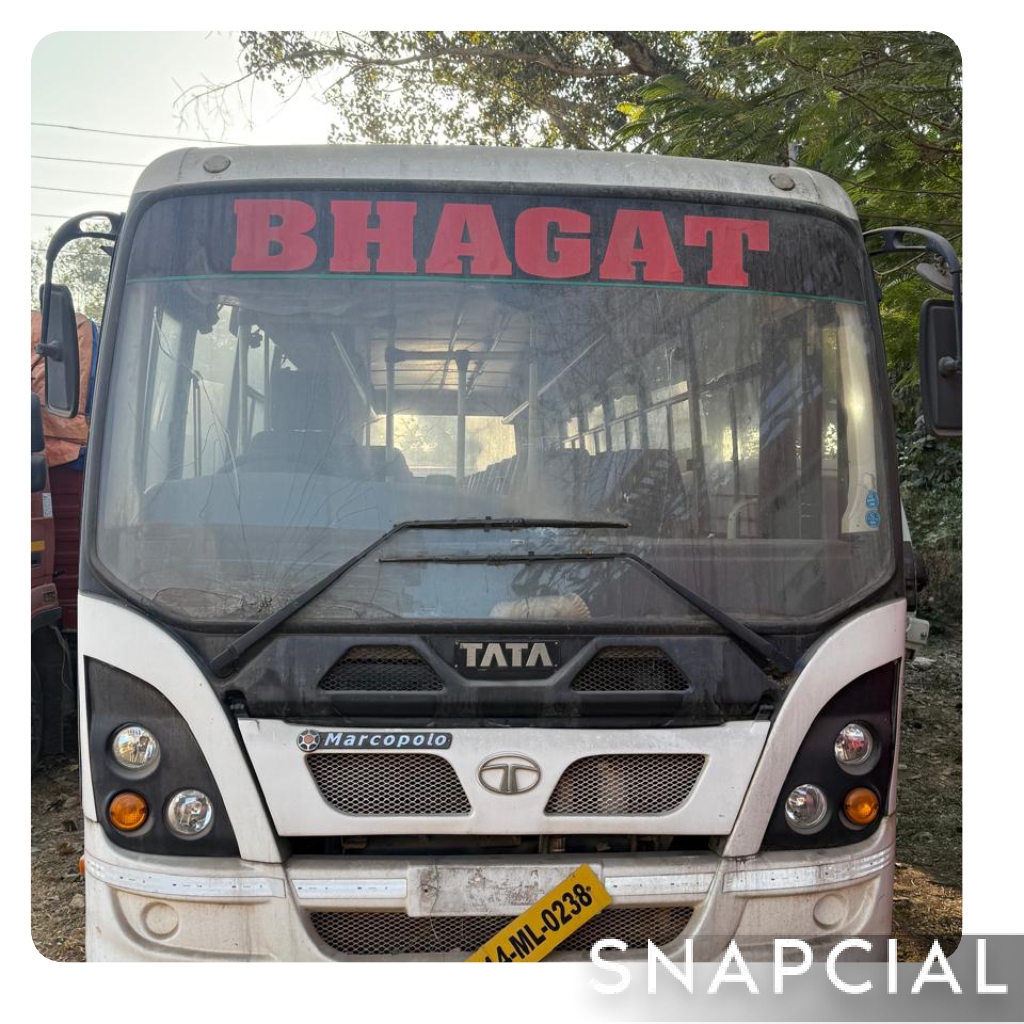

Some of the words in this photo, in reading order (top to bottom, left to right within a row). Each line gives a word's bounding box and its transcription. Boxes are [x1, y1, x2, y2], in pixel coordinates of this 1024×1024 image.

[231, 198, 770, 287] BHAGAT
[460, 642, 553, 667] TATA
[324, 731, 448, 748] Marcopolo
[484, 883, 593, 962] 4-ML-0238
